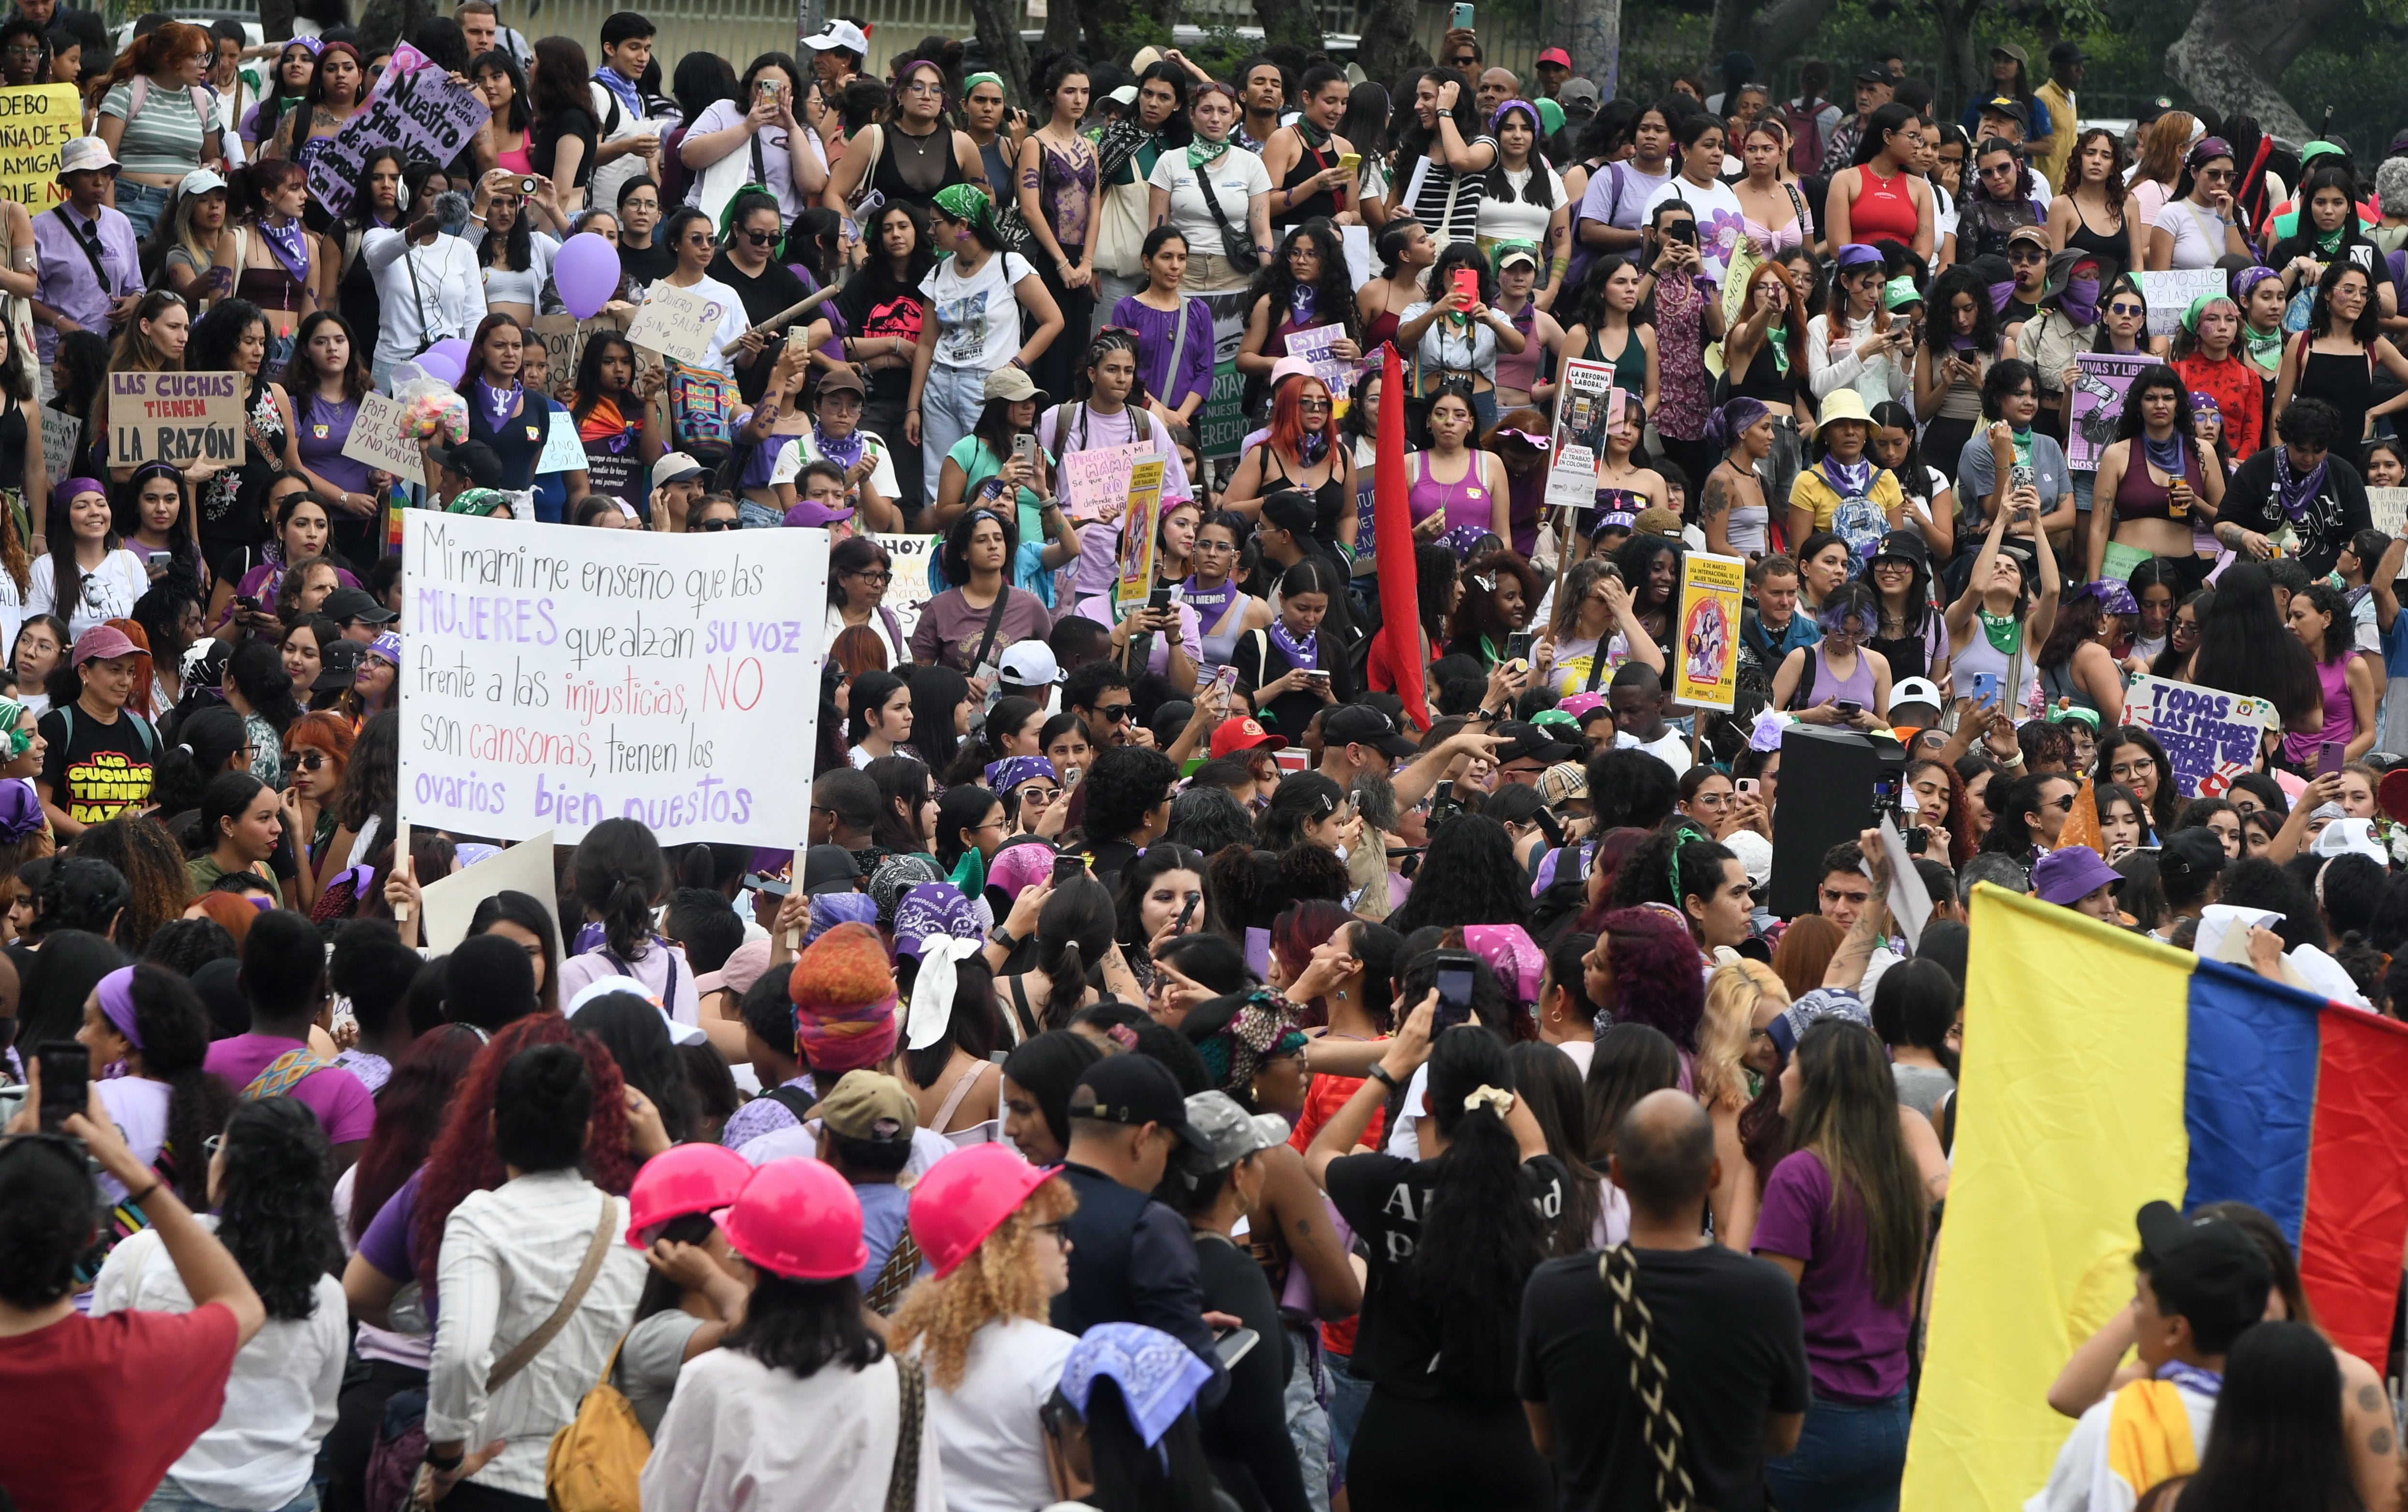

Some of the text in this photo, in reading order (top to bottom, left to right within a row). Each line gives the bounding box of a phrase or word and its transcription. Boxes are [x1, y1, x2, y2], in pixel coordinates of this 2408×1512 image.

[383, 69, 459, 148] Nuestro
[33, 126, 54, 145] DE
[59, 124, 71, 145] 5
[338, 120, 360, 149] de
[2144, 271, 2198, 288] SOMOS
[2147, 290, 2189, 304] DE LAS
[2148, 307, 2170, 320] QUE
[644, 315, 703, 337] SIN SALIR
[1289, 325, 1342, 351] ESTAR
[665, 342, 696, 361] MIEDO
[953, 346, 983, 358] EMPIRE
[2077, 361, 2109, 374] VIVAS
[2113, 363, 2119, 375] Y
[1574, 379, 1602, 389] LABORAL
[1581, 372, 1608, 382] REFORMA
[114, 374, 235, 397] LAS CUCHAS
[144, 399, 206, 418] TIENEN
[364, 399, 387, 420] POR
[355, 414, 383, 436] QUE
[118, 421, 235, 462] LA RAZÓN
[558, 440, 574, 451] NO
[1565, 447, 1590, 455] DIGNIFICA
[1569, 454, 1590, 463] TRABAJO
[551, 453, 585, 467] SOLA
[587, 456, 604, 465] cuerpo
[1566, 460, 1591, 469] COLOMBIA
[2071, 458, 2093, 470] NOS
[1103, 479, 1122, 494] NO
[1084, 496, 1112, 508] depende
[882, 540, 925, 554] HOY
[423, 521, 763, 619] Mi mami me enseño que las
[1697, 568, 1728, 579] INTERNACIONAL
[1707, 577, 1735, 585] TRABAJADORA
[1196, 594, 1226, 604] MENOS
[1997, 617, 2004, 625] EL
[419, 588, 801, 671] MUJERES que alzan SU VOZ
[418, 645, 763, 727] frente a las injusticias, NO
[1720, 677, 1732, 686] #8M
[2151, 683, 2231, 719] TODAS
[2152, 708, 2259, 747] LAS MADRES
[421, 714, 713, 778] son cansonas, tienen los
[2220, 741, 2254, 766] VER
[96, 755, 126, 768] LAS
[69, 767, 153, 782] CUCHAS
[71, 784, 151, 800] TIENEN
[415, 771, 505, 814] ovarios
[535, 773, 603, 826] bien
